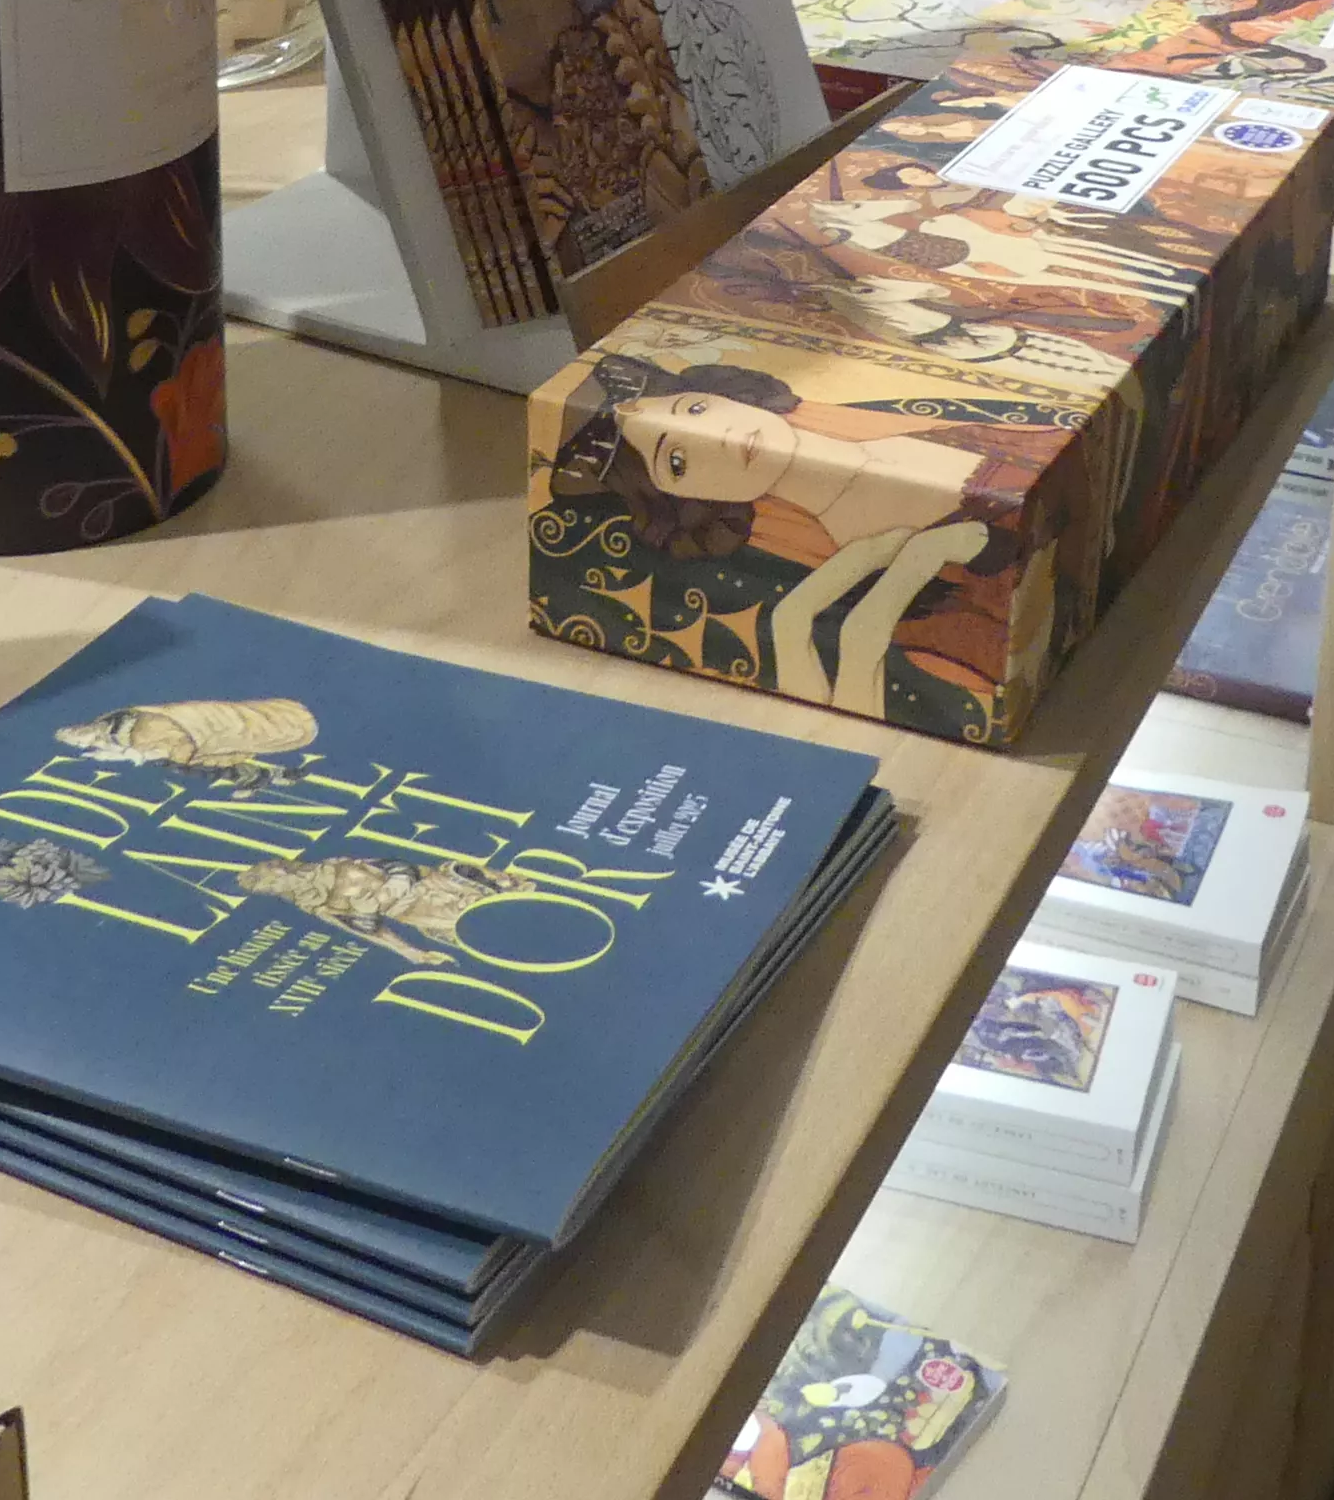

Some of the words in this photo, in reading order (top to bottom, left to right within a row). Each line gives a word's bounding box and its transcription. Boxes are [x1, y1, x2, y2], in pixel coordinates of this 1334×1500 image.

[1022, 151, 1080, 190] PUZZLE
[1065, 107, 1125, 151] GALLERY
[1059, 158, 1143, 202] 500
[1103, 113, 1187, 158] PCS
[344, 771, 535, 866] ET
[555, 782, 621, 840] Journal
[598, 764, 687, 846] d'exposition
[645, 822, 691, 860] juillet
[673, 793, 709, 823] 2025
[728, 796, 793, 875] SAINT-ANTOINE
[714, 833, 750, 872] MUSÉE
[739, 818, 760, 835] DE
[742, 829, 786, 879] L'ABBAYE
[187, 965, 240, 995] Une
[217, 920, 292, 968] histoire
[298, 930, 332, 951] au
